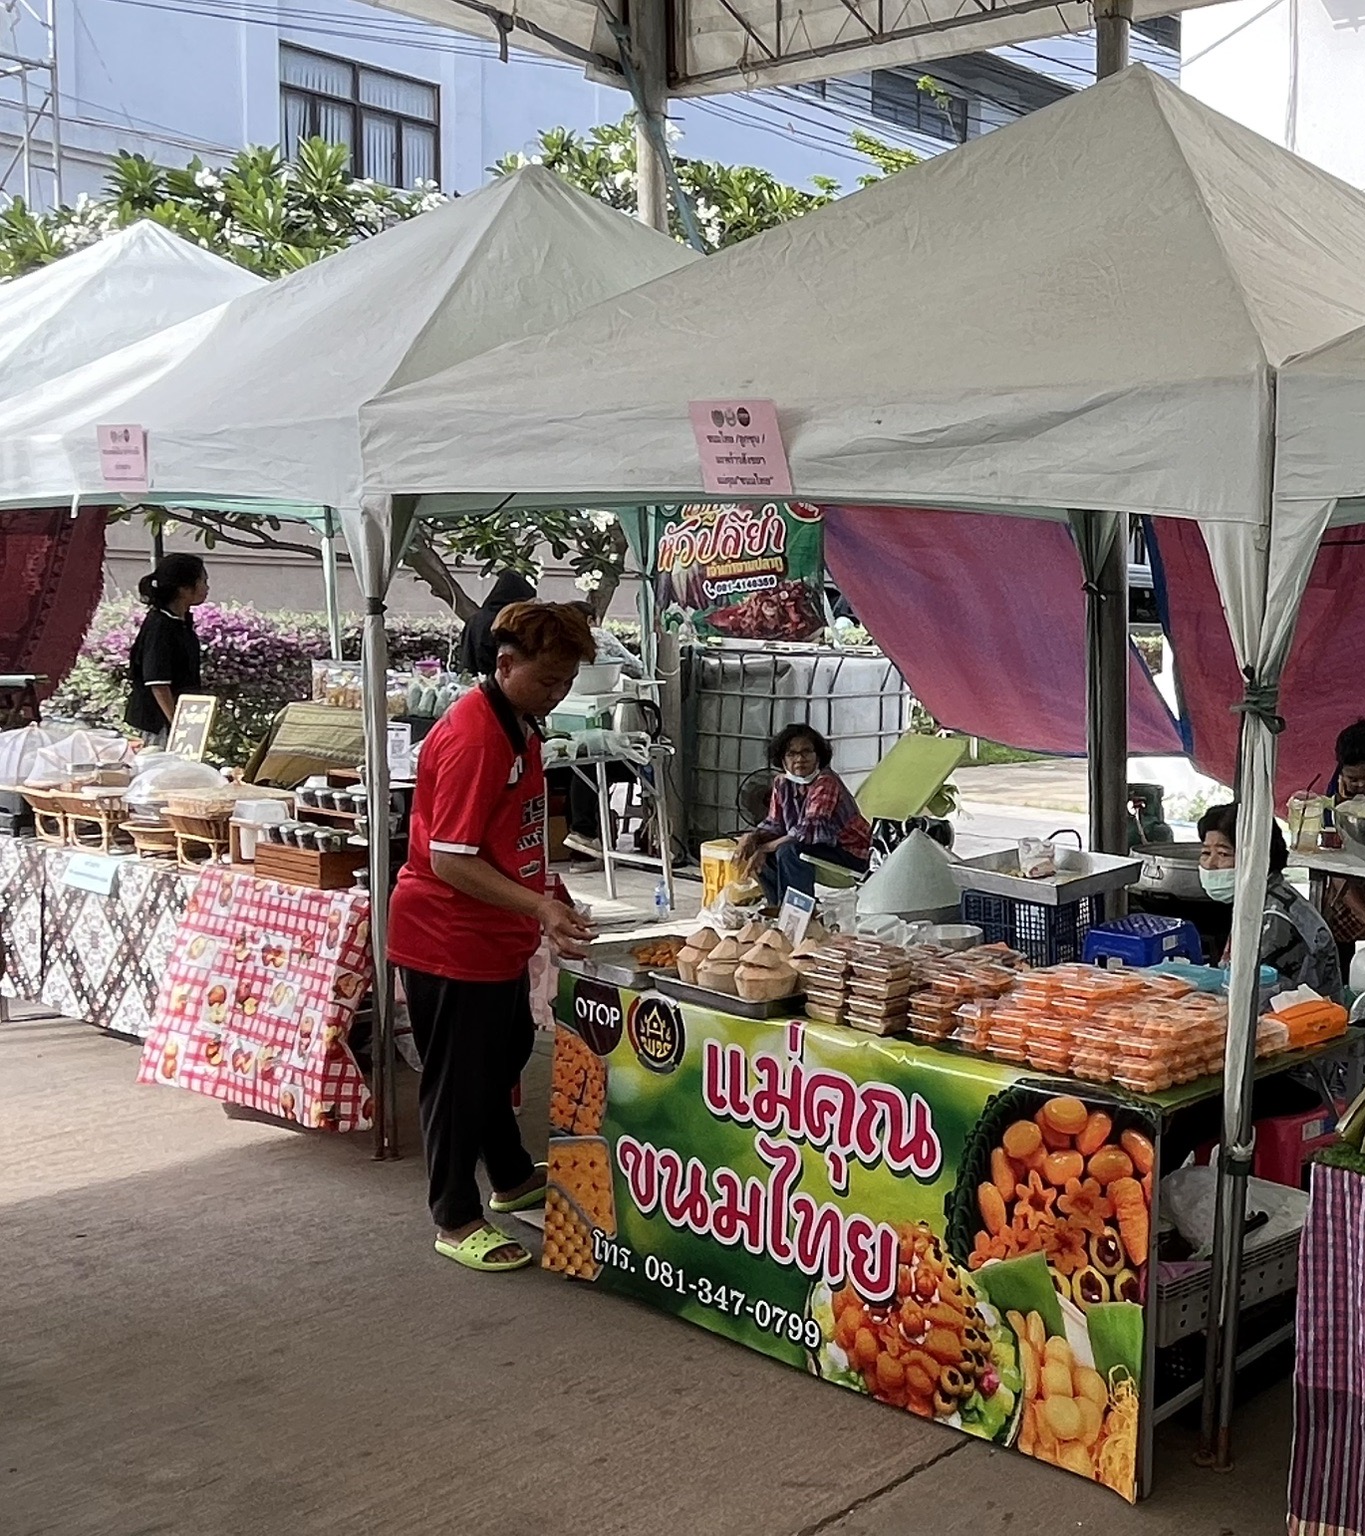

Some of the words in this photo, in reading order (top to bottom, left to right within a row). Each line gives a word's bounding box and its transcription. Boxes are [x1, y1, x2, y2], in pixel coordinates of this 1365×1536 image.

[575, 996, 620, 1028] OTOP
[702, 1021, 942, 1190] แม่คุณ
[616, 1131, 900, 1302] ขนมไทย
[592, 1229, 636, 1273] โทร.
[644, 1255, 821, 1349] 081-347-0799
